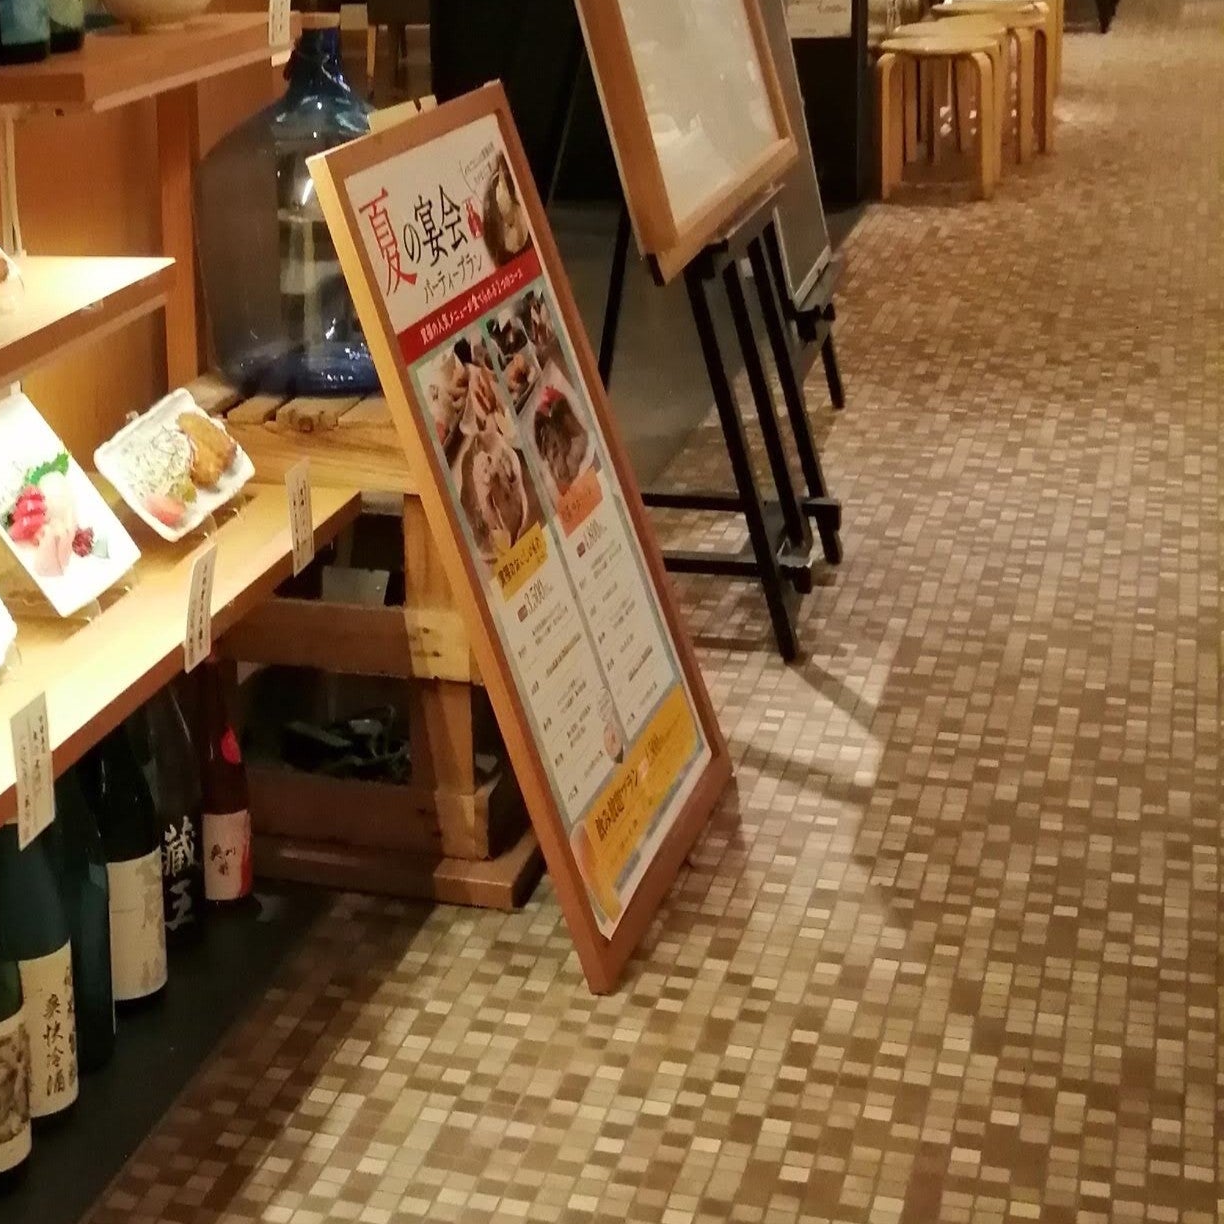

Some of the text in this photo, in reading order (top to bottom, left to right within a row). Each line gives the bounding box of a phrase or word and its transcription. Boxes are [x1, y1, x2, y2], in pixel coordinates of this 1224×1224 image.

[359, 184, 468, 297] 夏の宴会
[423, 253, 483, 304] パーティープラン
